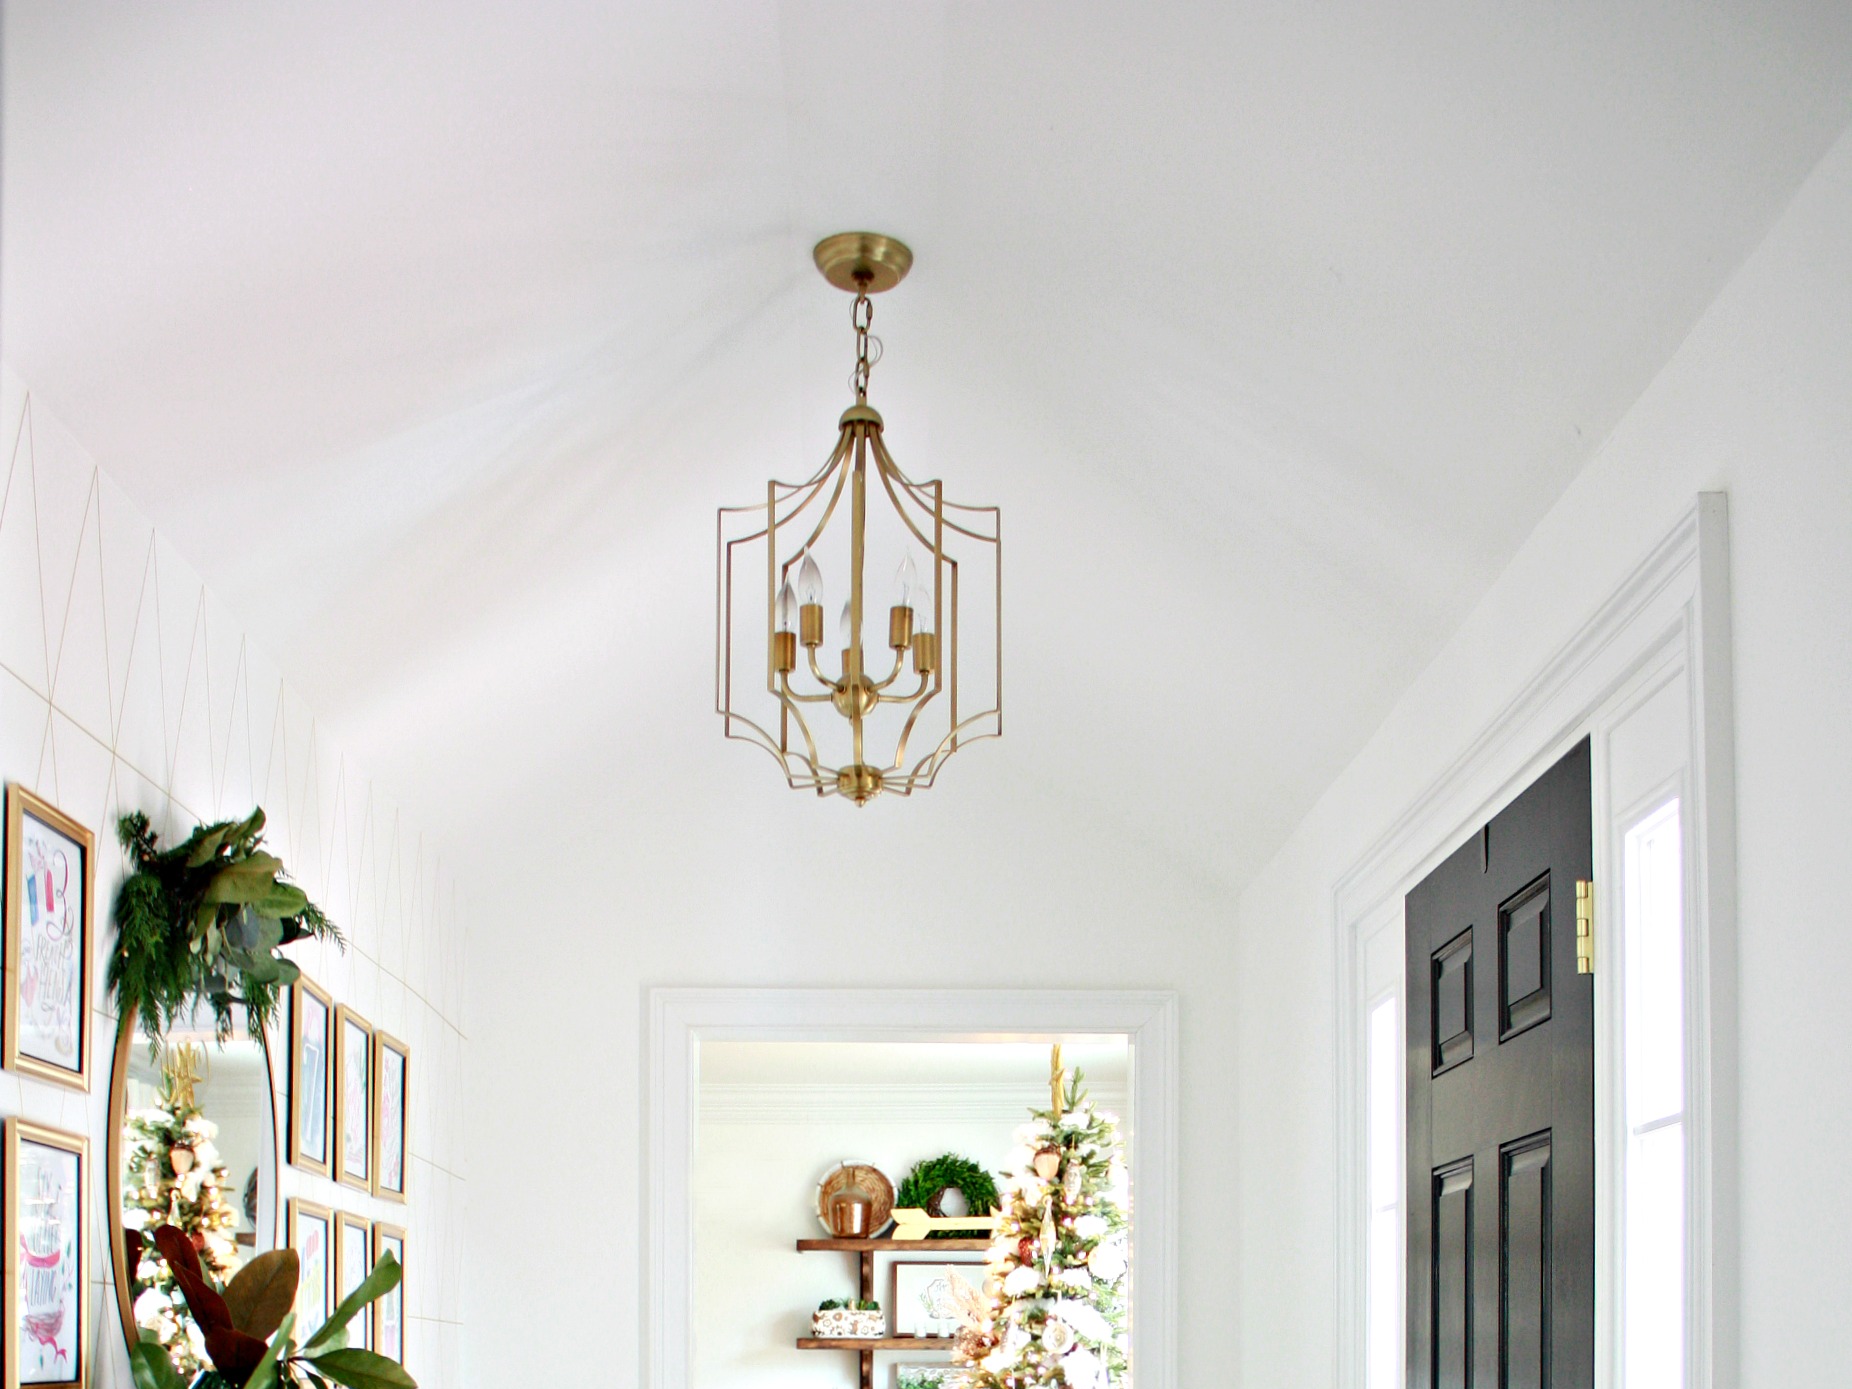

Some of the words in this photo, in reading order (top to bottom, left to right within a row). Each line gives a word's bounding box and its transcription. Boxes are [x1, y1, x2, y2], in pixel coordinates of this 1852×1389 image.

[46, 850, 68, 943] 3
[303, 1043, 320, 1142] 7
[30, 1268, 57, 1307] LAYING
